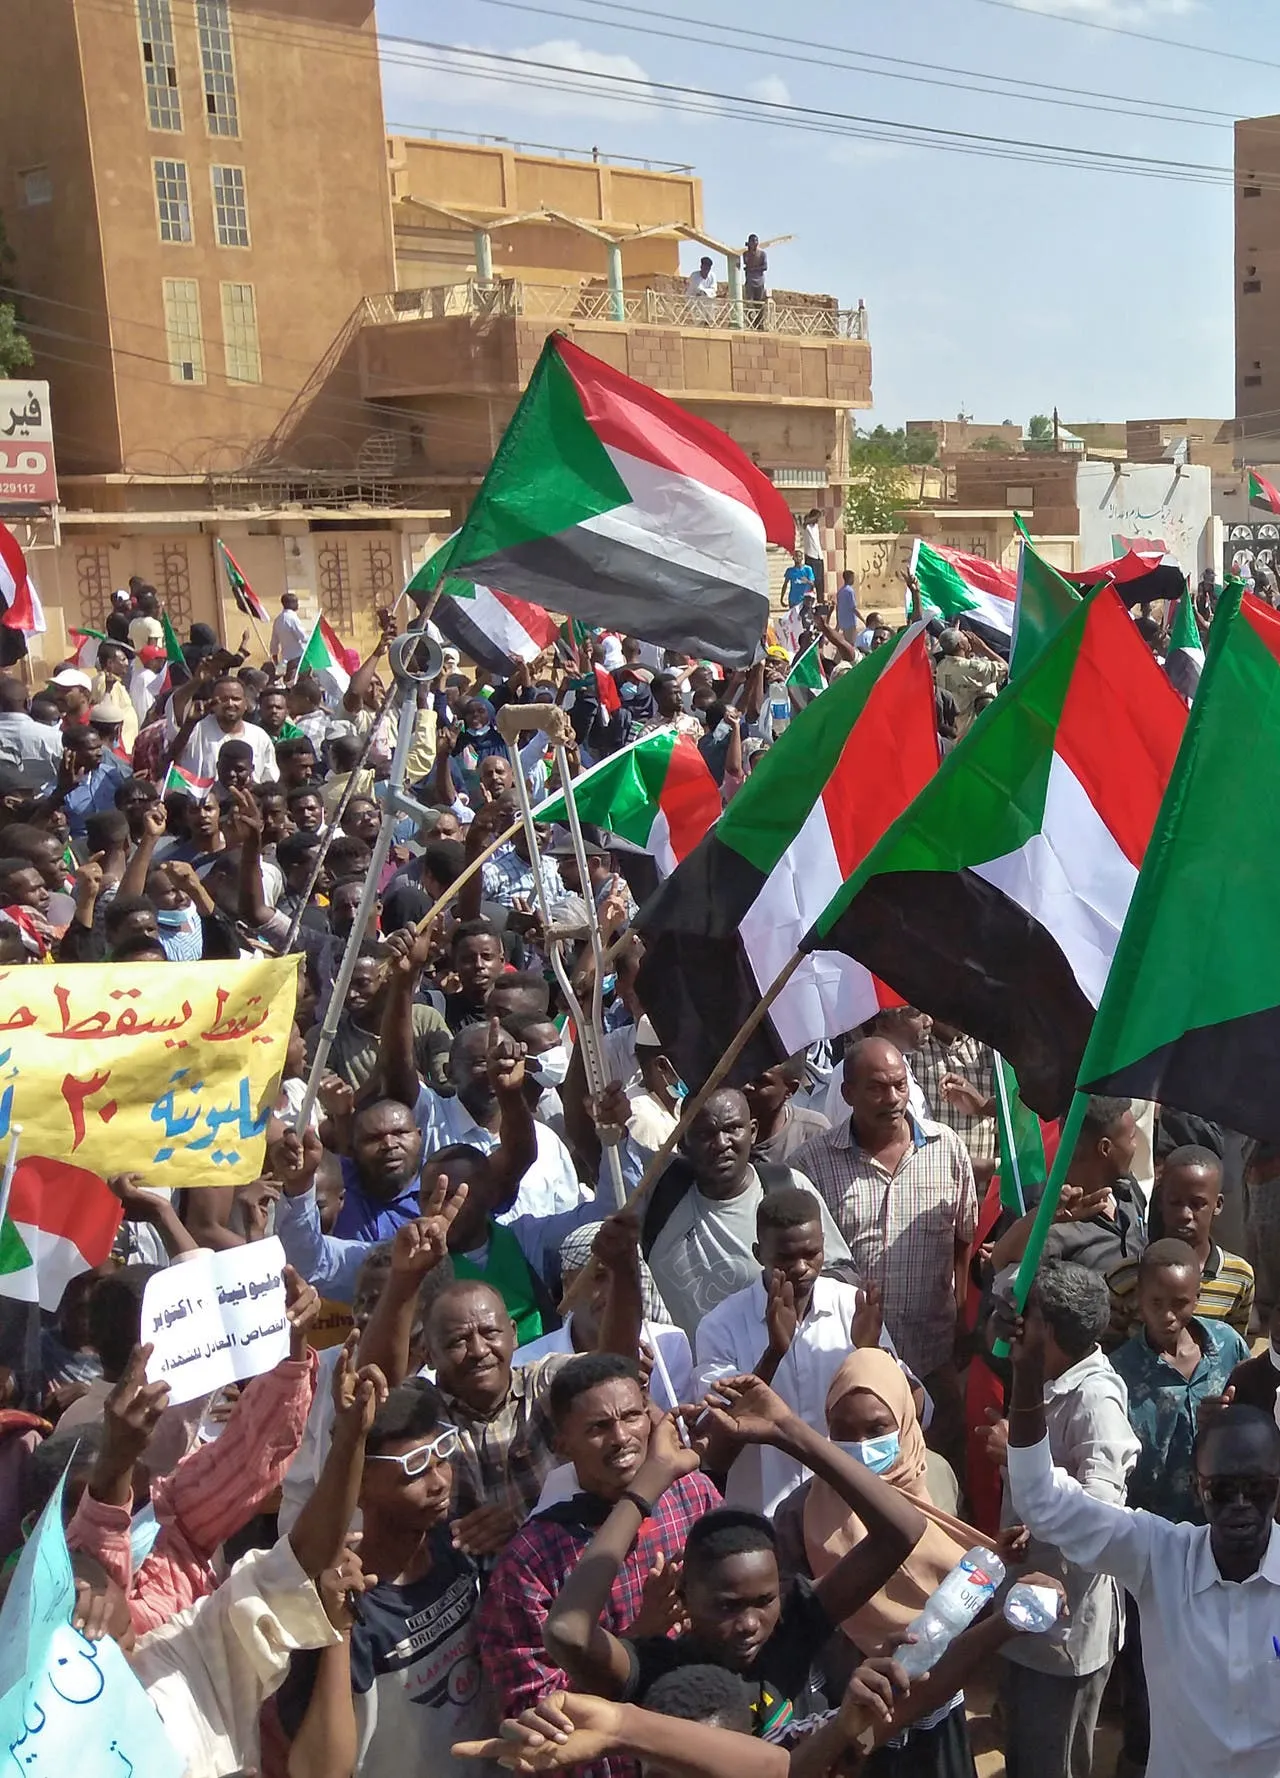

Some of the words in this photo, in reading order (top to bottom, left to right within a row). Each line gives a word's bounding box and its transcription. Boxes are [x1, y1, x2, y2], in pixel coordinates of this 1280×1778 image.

[46, 983, 192, 1048] يسقط
[216, 1273, 280, 1305] مليونية
[153, 1299, 193, 1333] اكتوبر
[240, 1317, 286, 1347] القصاص
[161, 1346, 202, 1373] للشهداء
[411, 1607, 458, 1649] ORINAL
